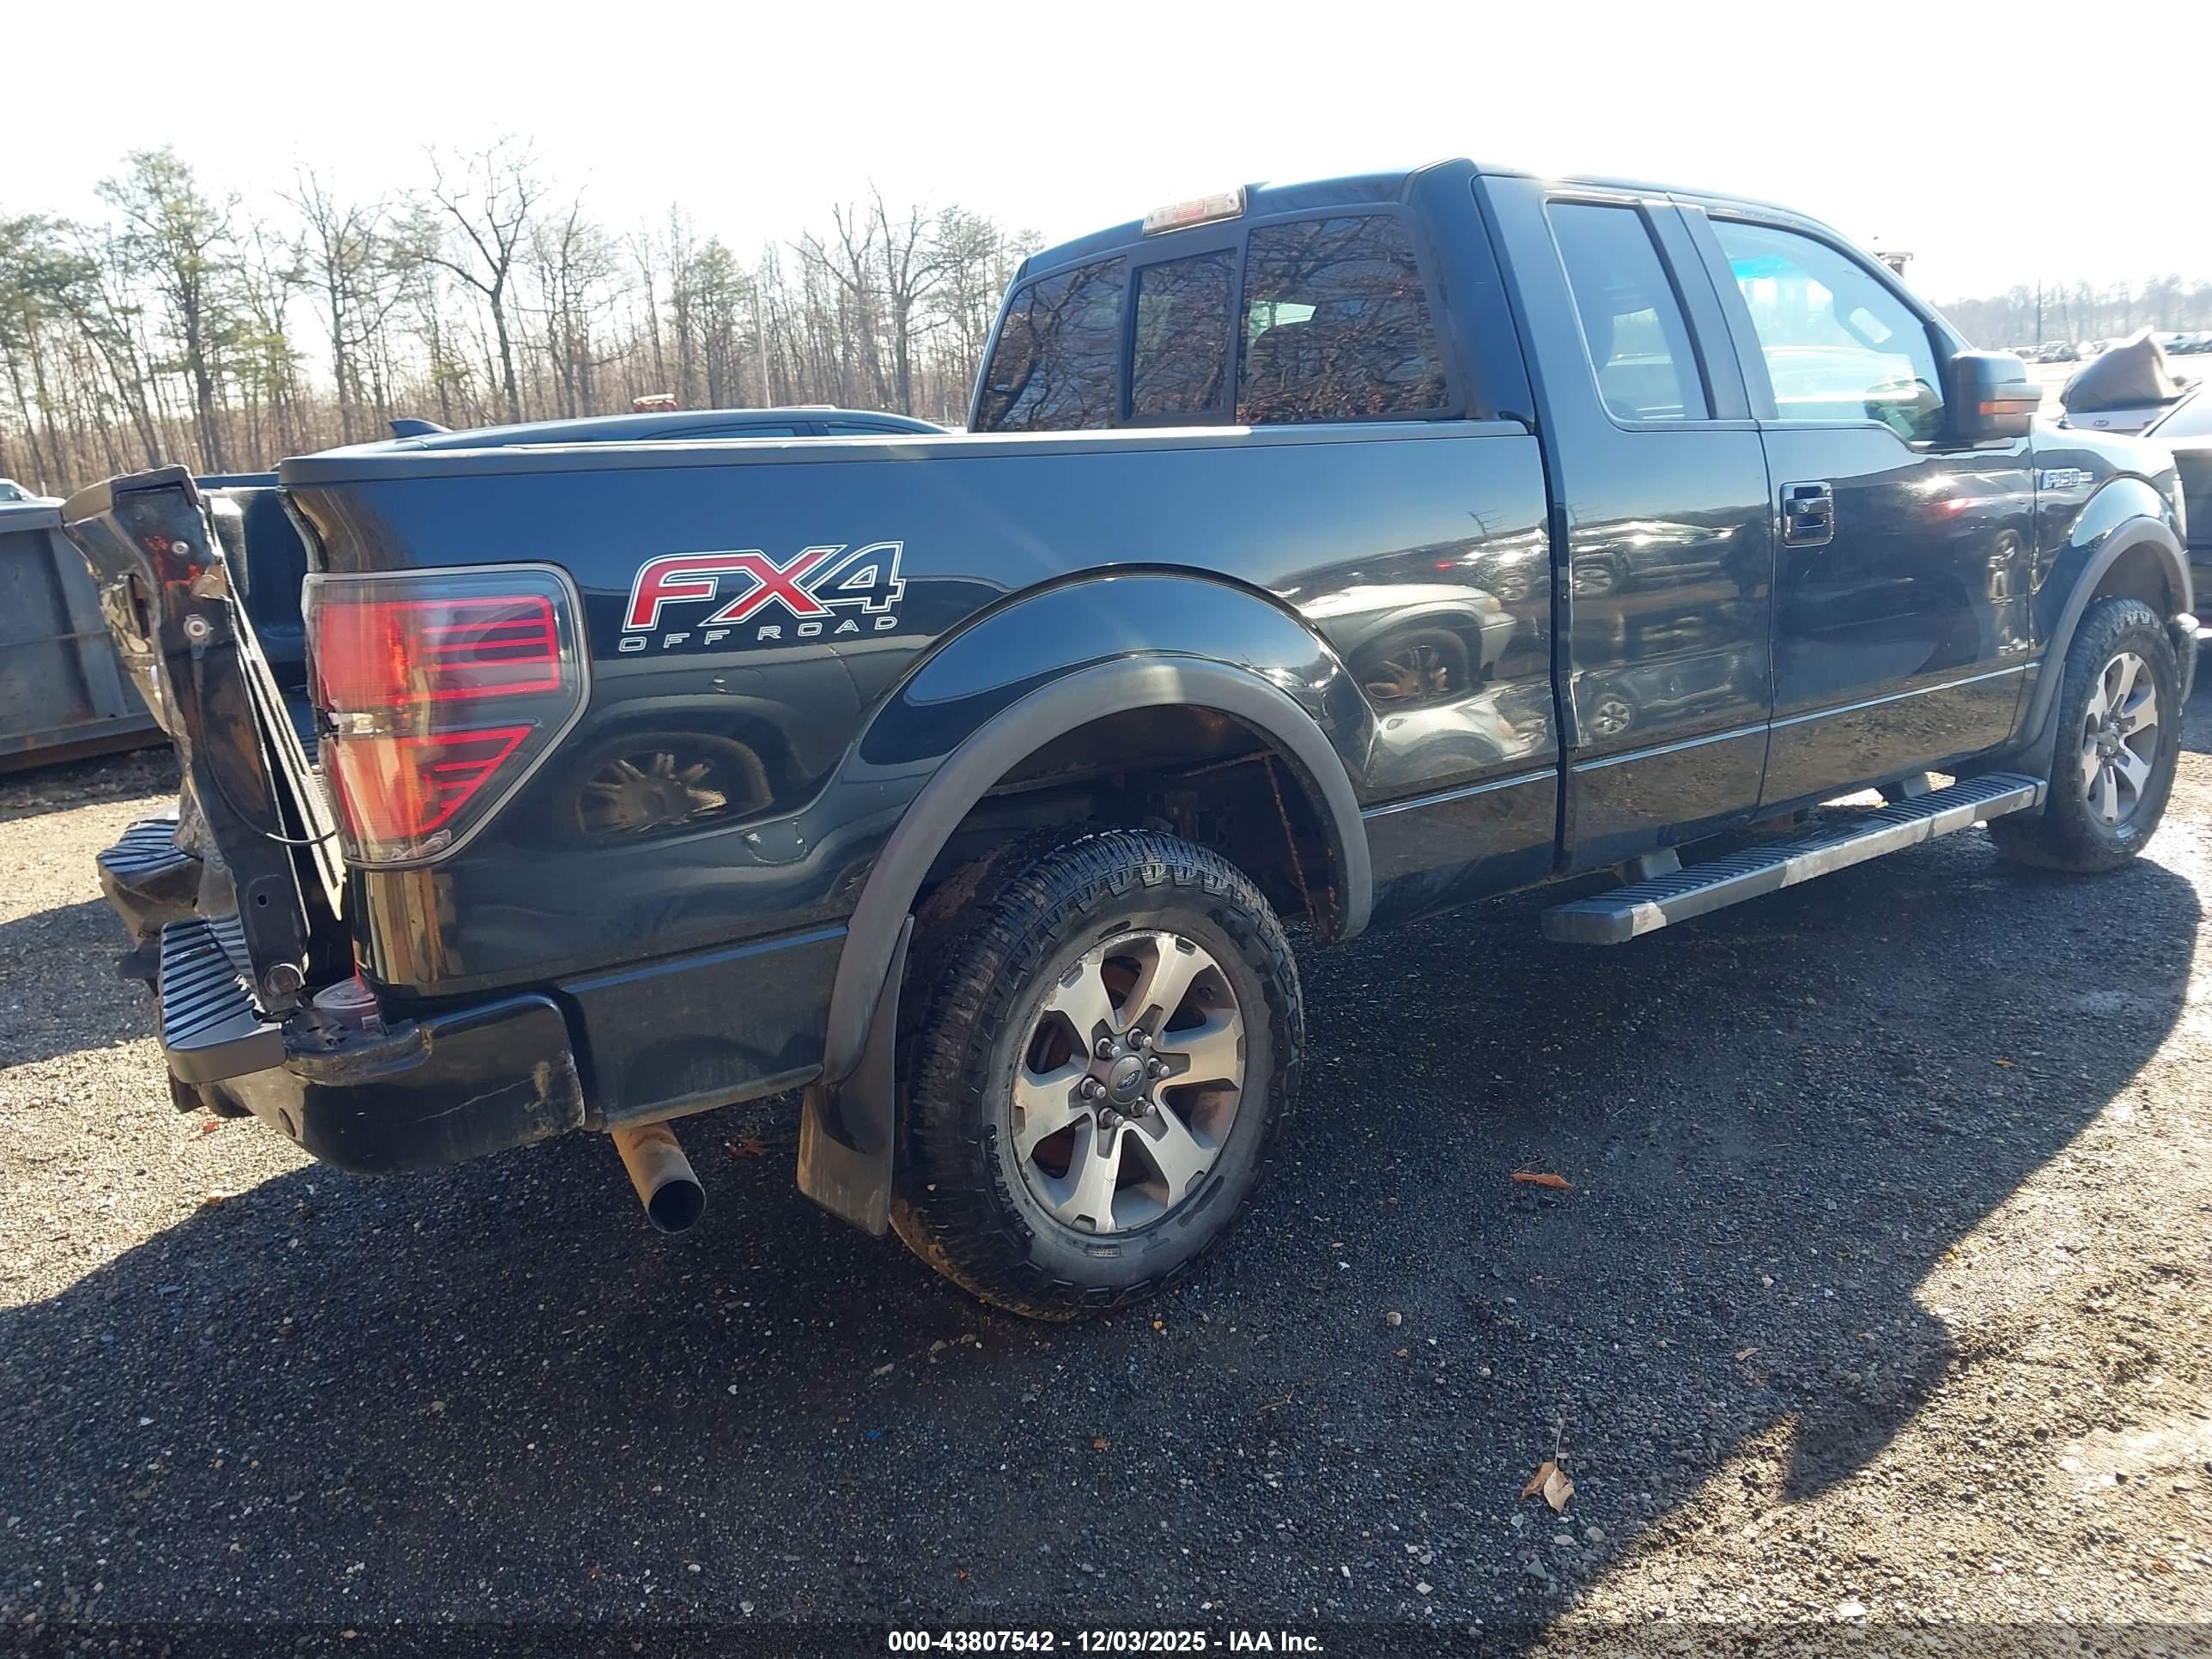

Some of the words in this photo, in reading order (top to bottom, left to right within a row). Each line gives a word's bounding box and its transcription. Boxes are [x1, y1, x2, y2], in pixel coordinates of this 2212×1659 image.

[622, 541, 906, 633] FX4
[618, 629, 731, 653] OFF
[757, 616, 898, 641] ROAD
